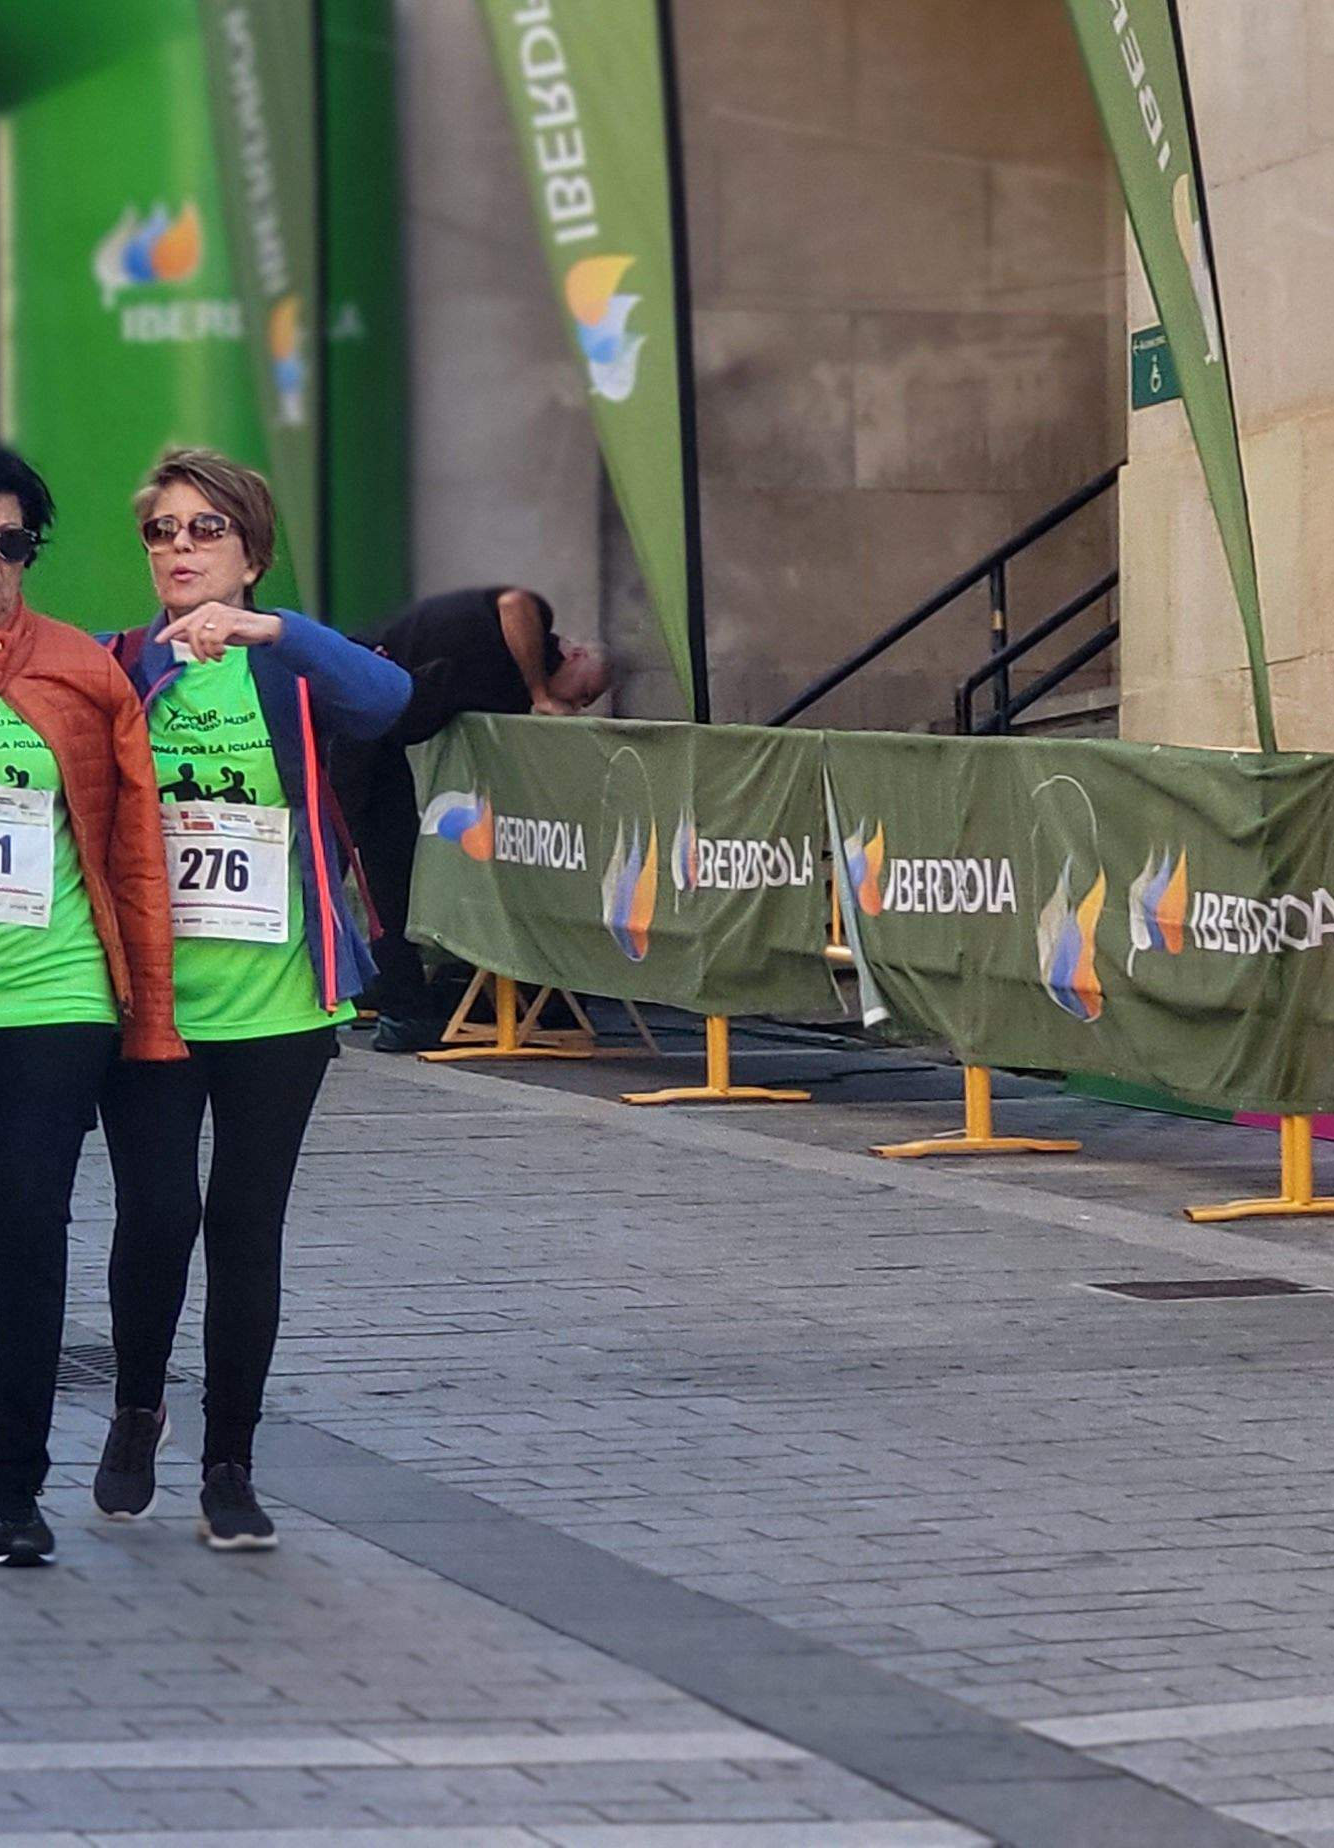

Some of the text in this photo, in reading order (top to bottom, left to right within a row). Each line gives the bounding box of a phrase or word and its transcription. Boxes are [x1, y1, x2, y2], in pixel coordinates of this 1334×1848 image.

[182, 744, 206, 755] POR
[209, 743, 225, 754] LA
[495, 815, 586, 871] IBERDROLA
[178, 848, 250, 892] 276
